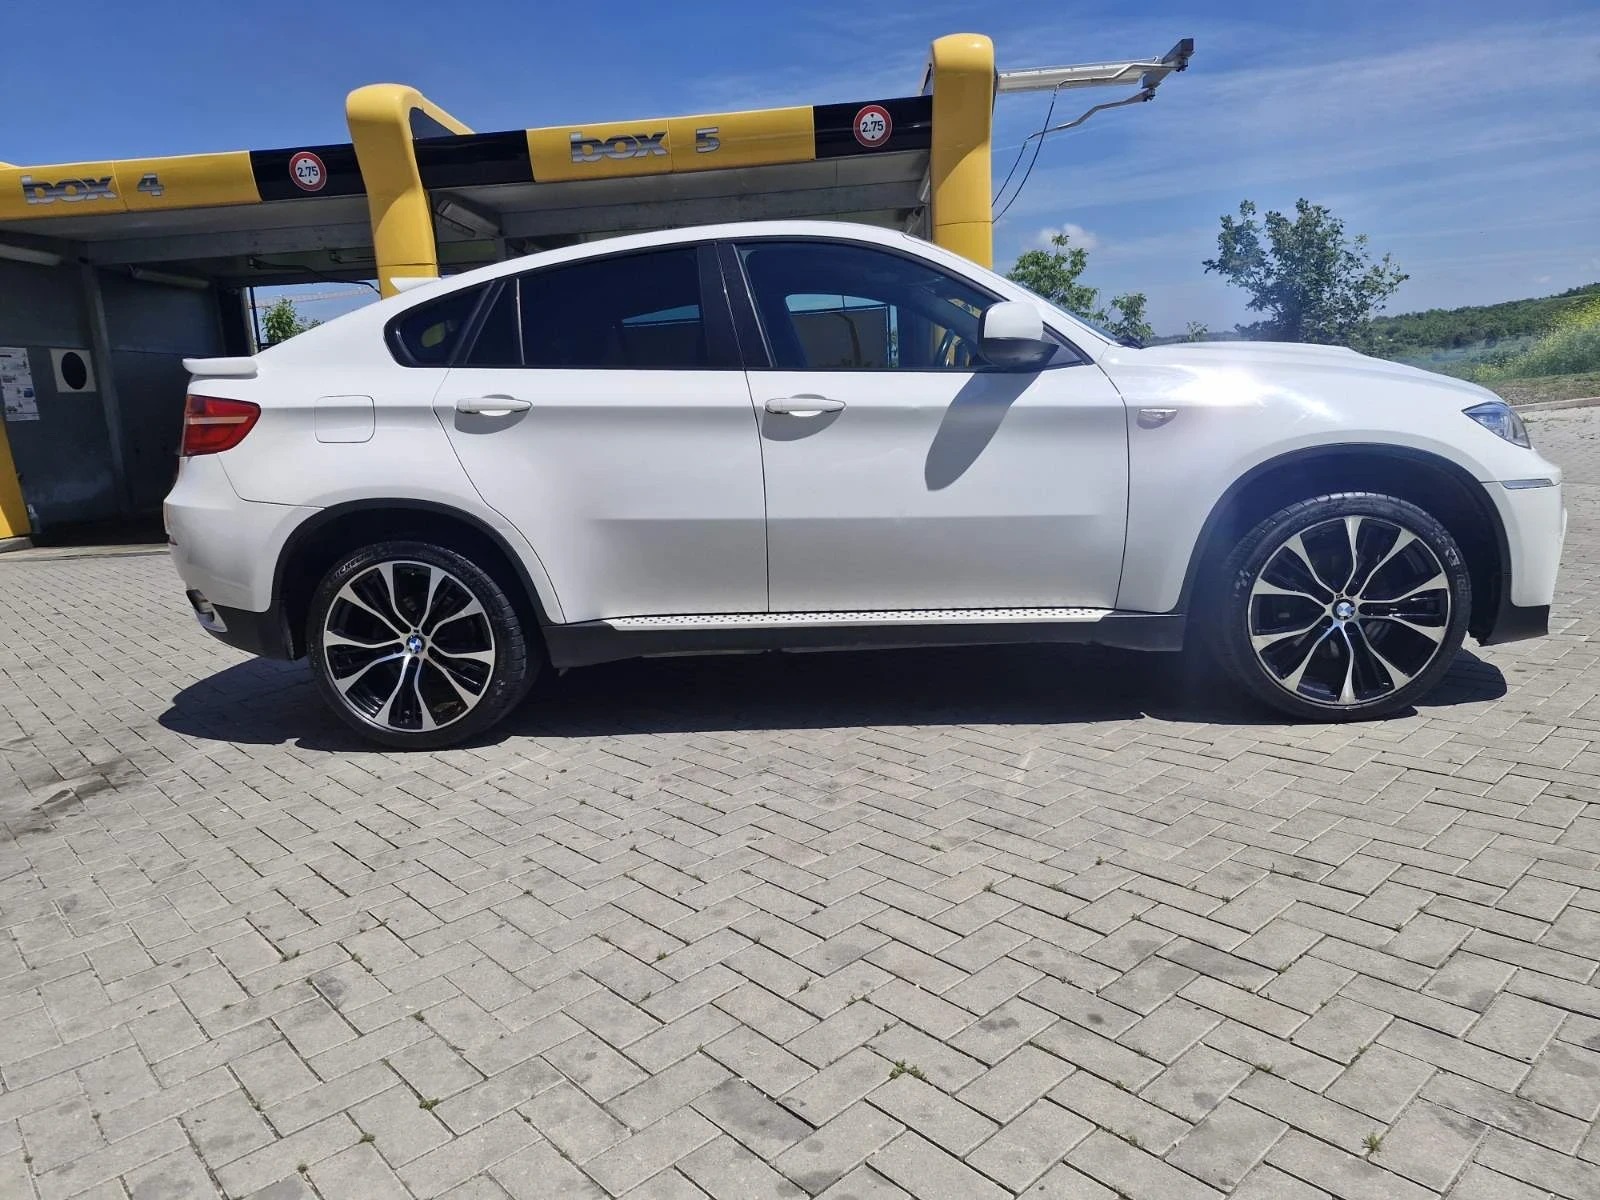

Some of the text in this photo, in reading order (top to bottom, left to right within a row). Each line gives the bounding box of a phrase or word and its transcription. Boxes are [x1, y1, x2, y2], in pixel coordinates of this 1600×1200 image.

[862, 120, 884, 133] 2.75
[570, 126, 720, 162] box 5
[297, 166, 319, 178] 2.75
[20, 173, 165, 205] box 4
